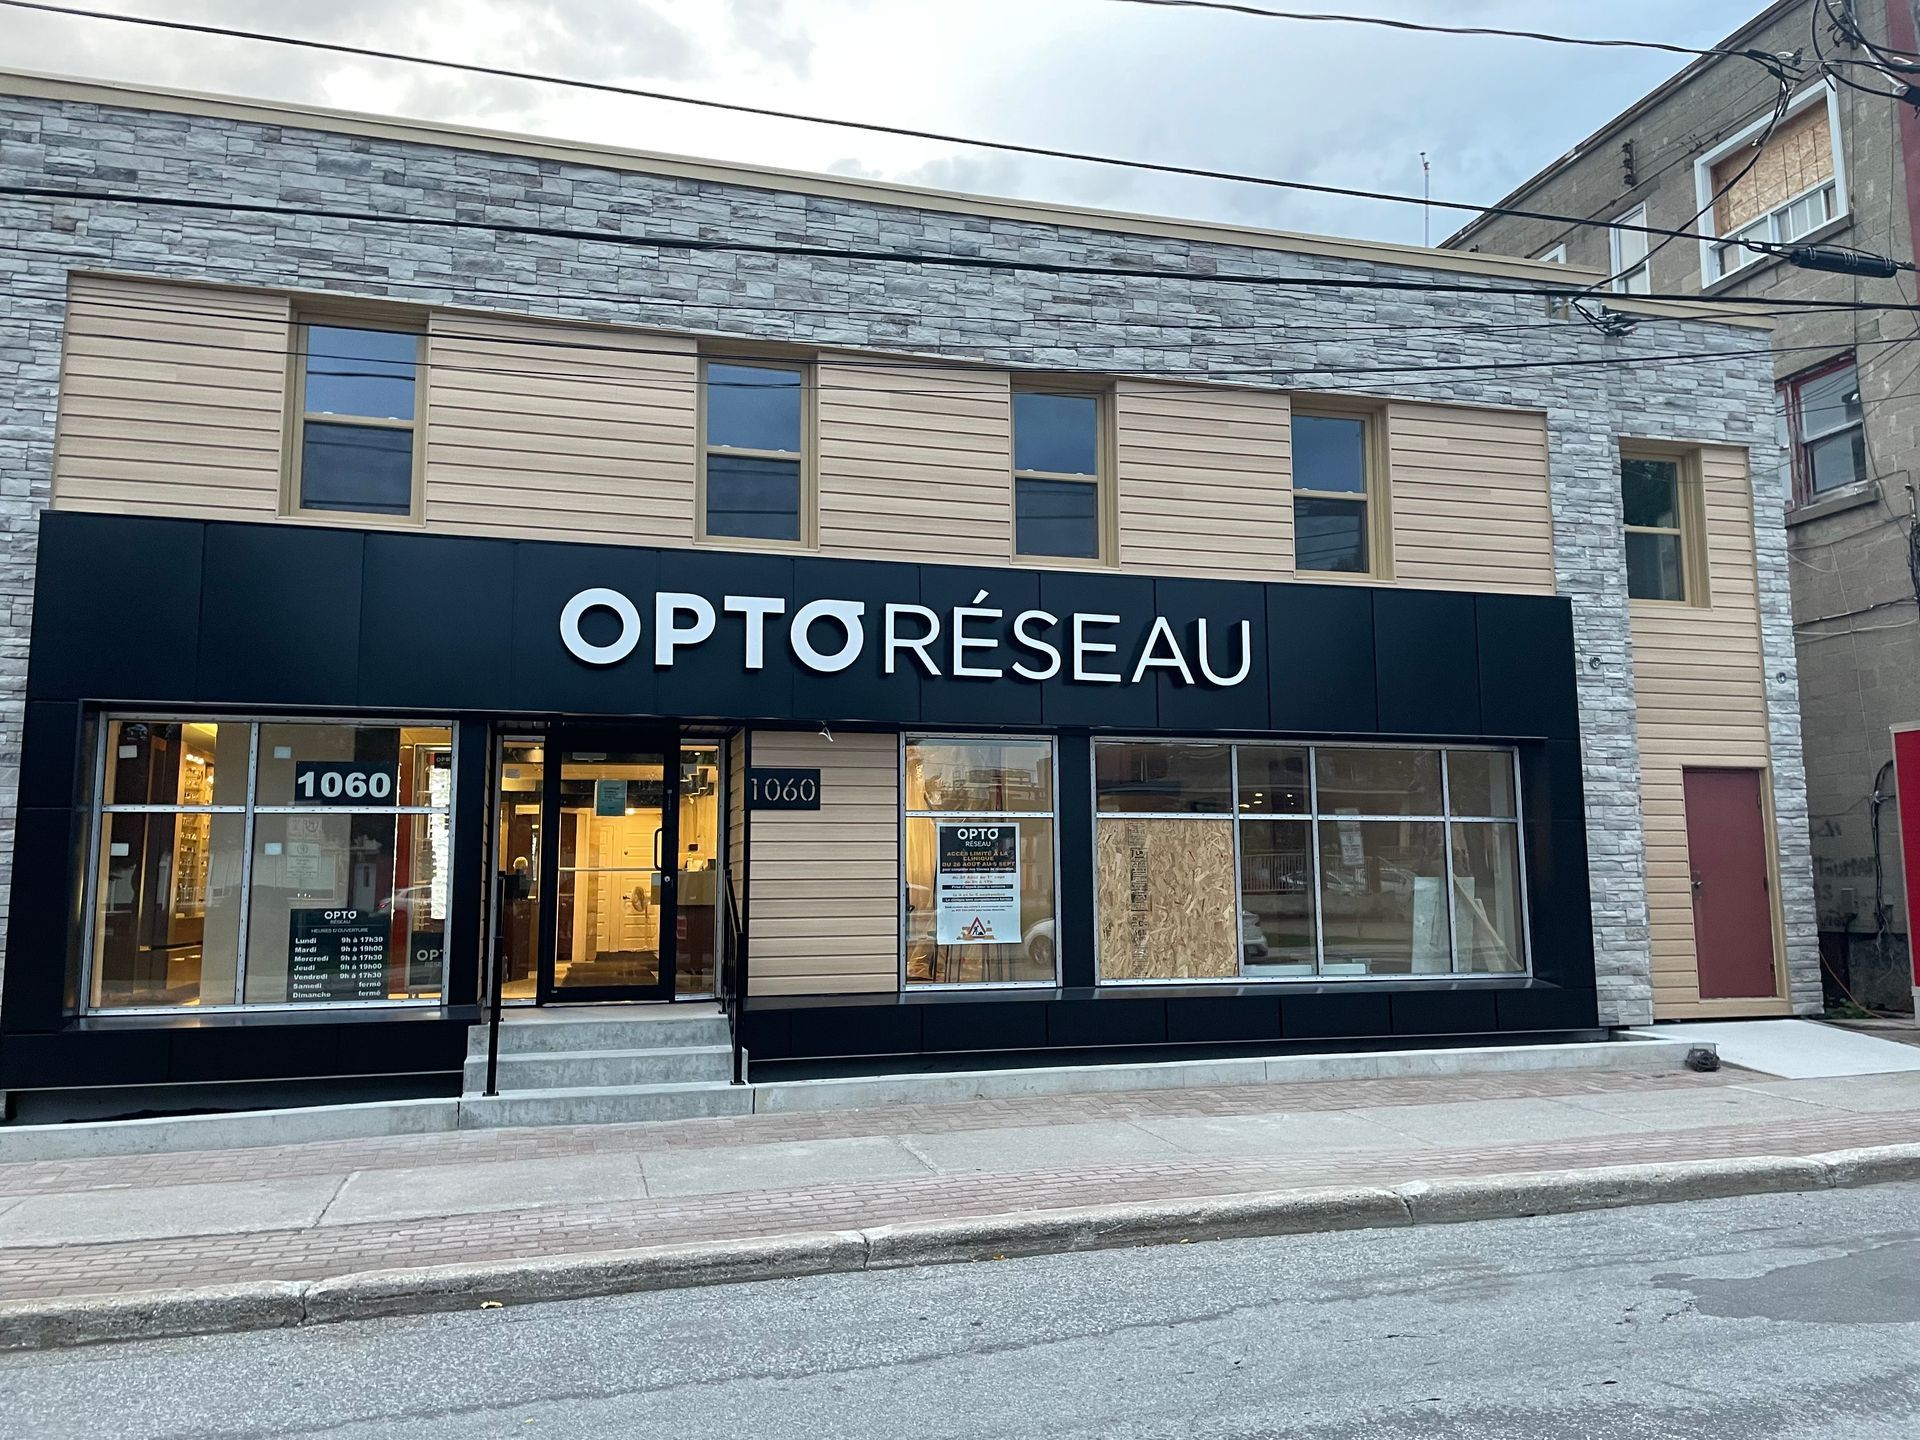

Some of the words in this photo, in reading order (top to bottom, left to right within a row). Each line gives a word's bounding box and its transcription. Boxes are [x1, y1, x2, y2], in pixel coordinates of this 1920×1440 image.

[297, 771, 391, 798] 1060
[751, 778, 816, 801] 1060
[957, 828, 999, 840] OPTO
[324, 911, 357, 919] OPTO
